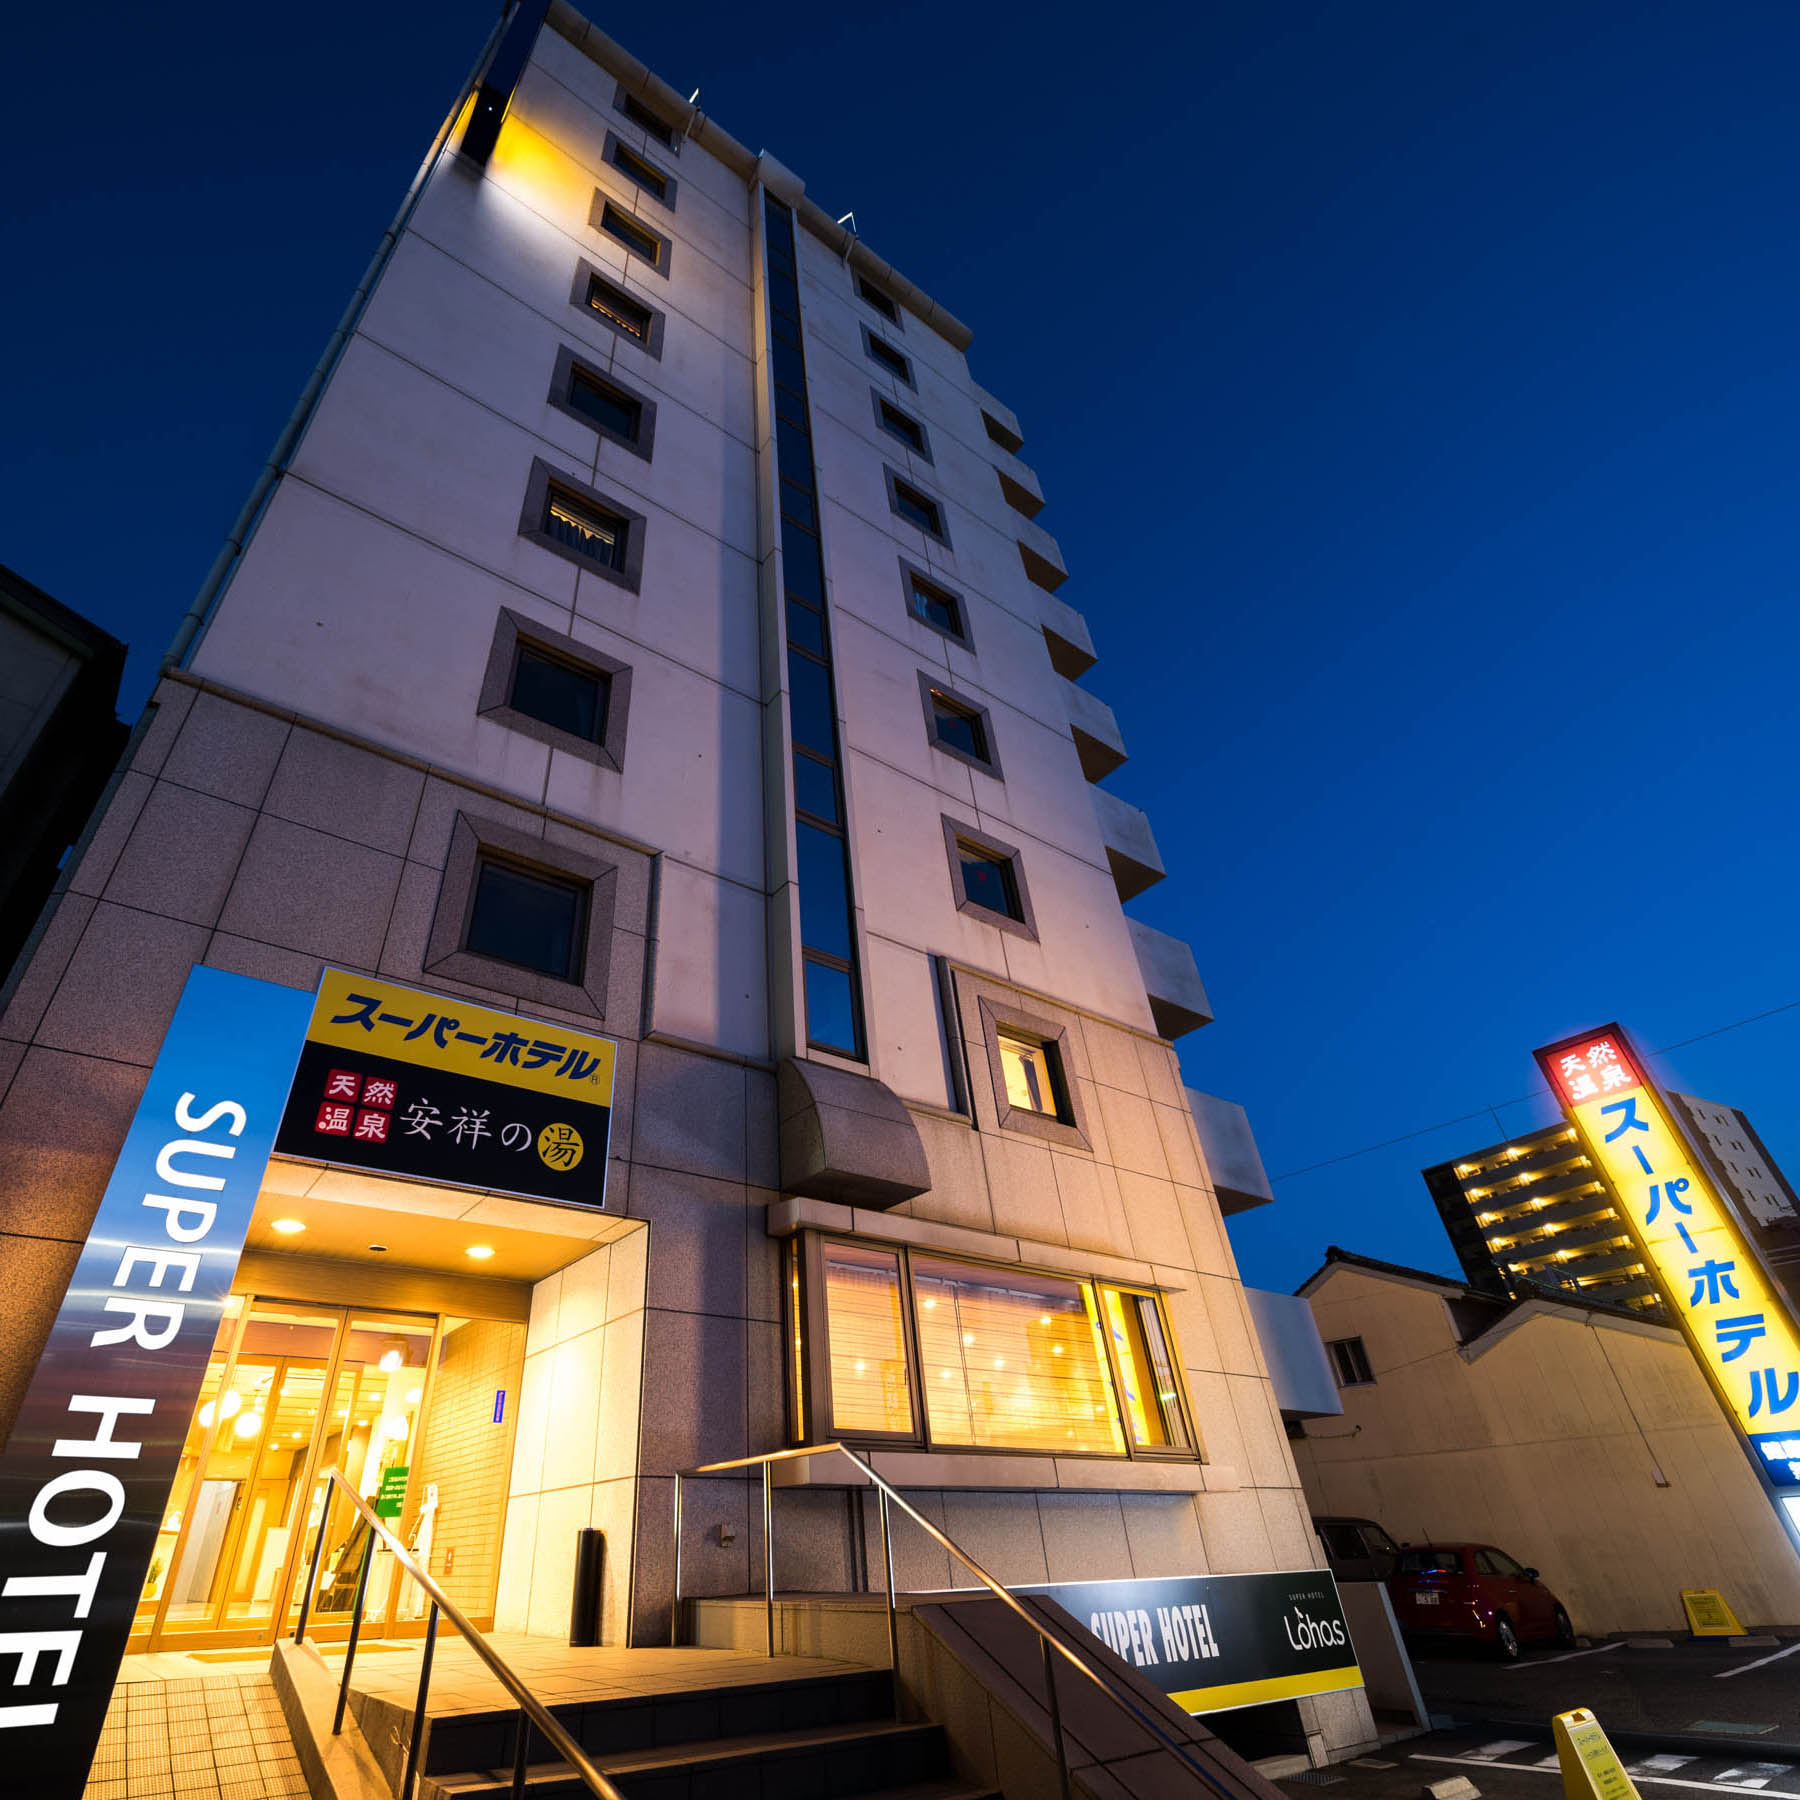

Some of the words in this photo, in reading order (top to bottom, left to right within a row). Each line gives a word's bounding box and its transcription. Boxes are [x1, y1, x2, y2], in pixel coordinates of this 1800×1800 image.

[330, 994, 601, 1080] スーパーホテル
[1560, 1041, 1616, 1078] 天然
[328, 1074, 394, 1105] 天然
[1568, 1064, 1632, 1100] 温泉
[319, 1106, 387, 1139] 温泉
[400, 1098, 580, 1168] 安祥の湯
[90, 1092, 247, 1350] SUPER
[1601, 1097, 1799, 1418] スーパーホテル
[1156, 1604, 1219, 1661] HOTEL
[1283, 1607, 1345, 1650] Lohas
